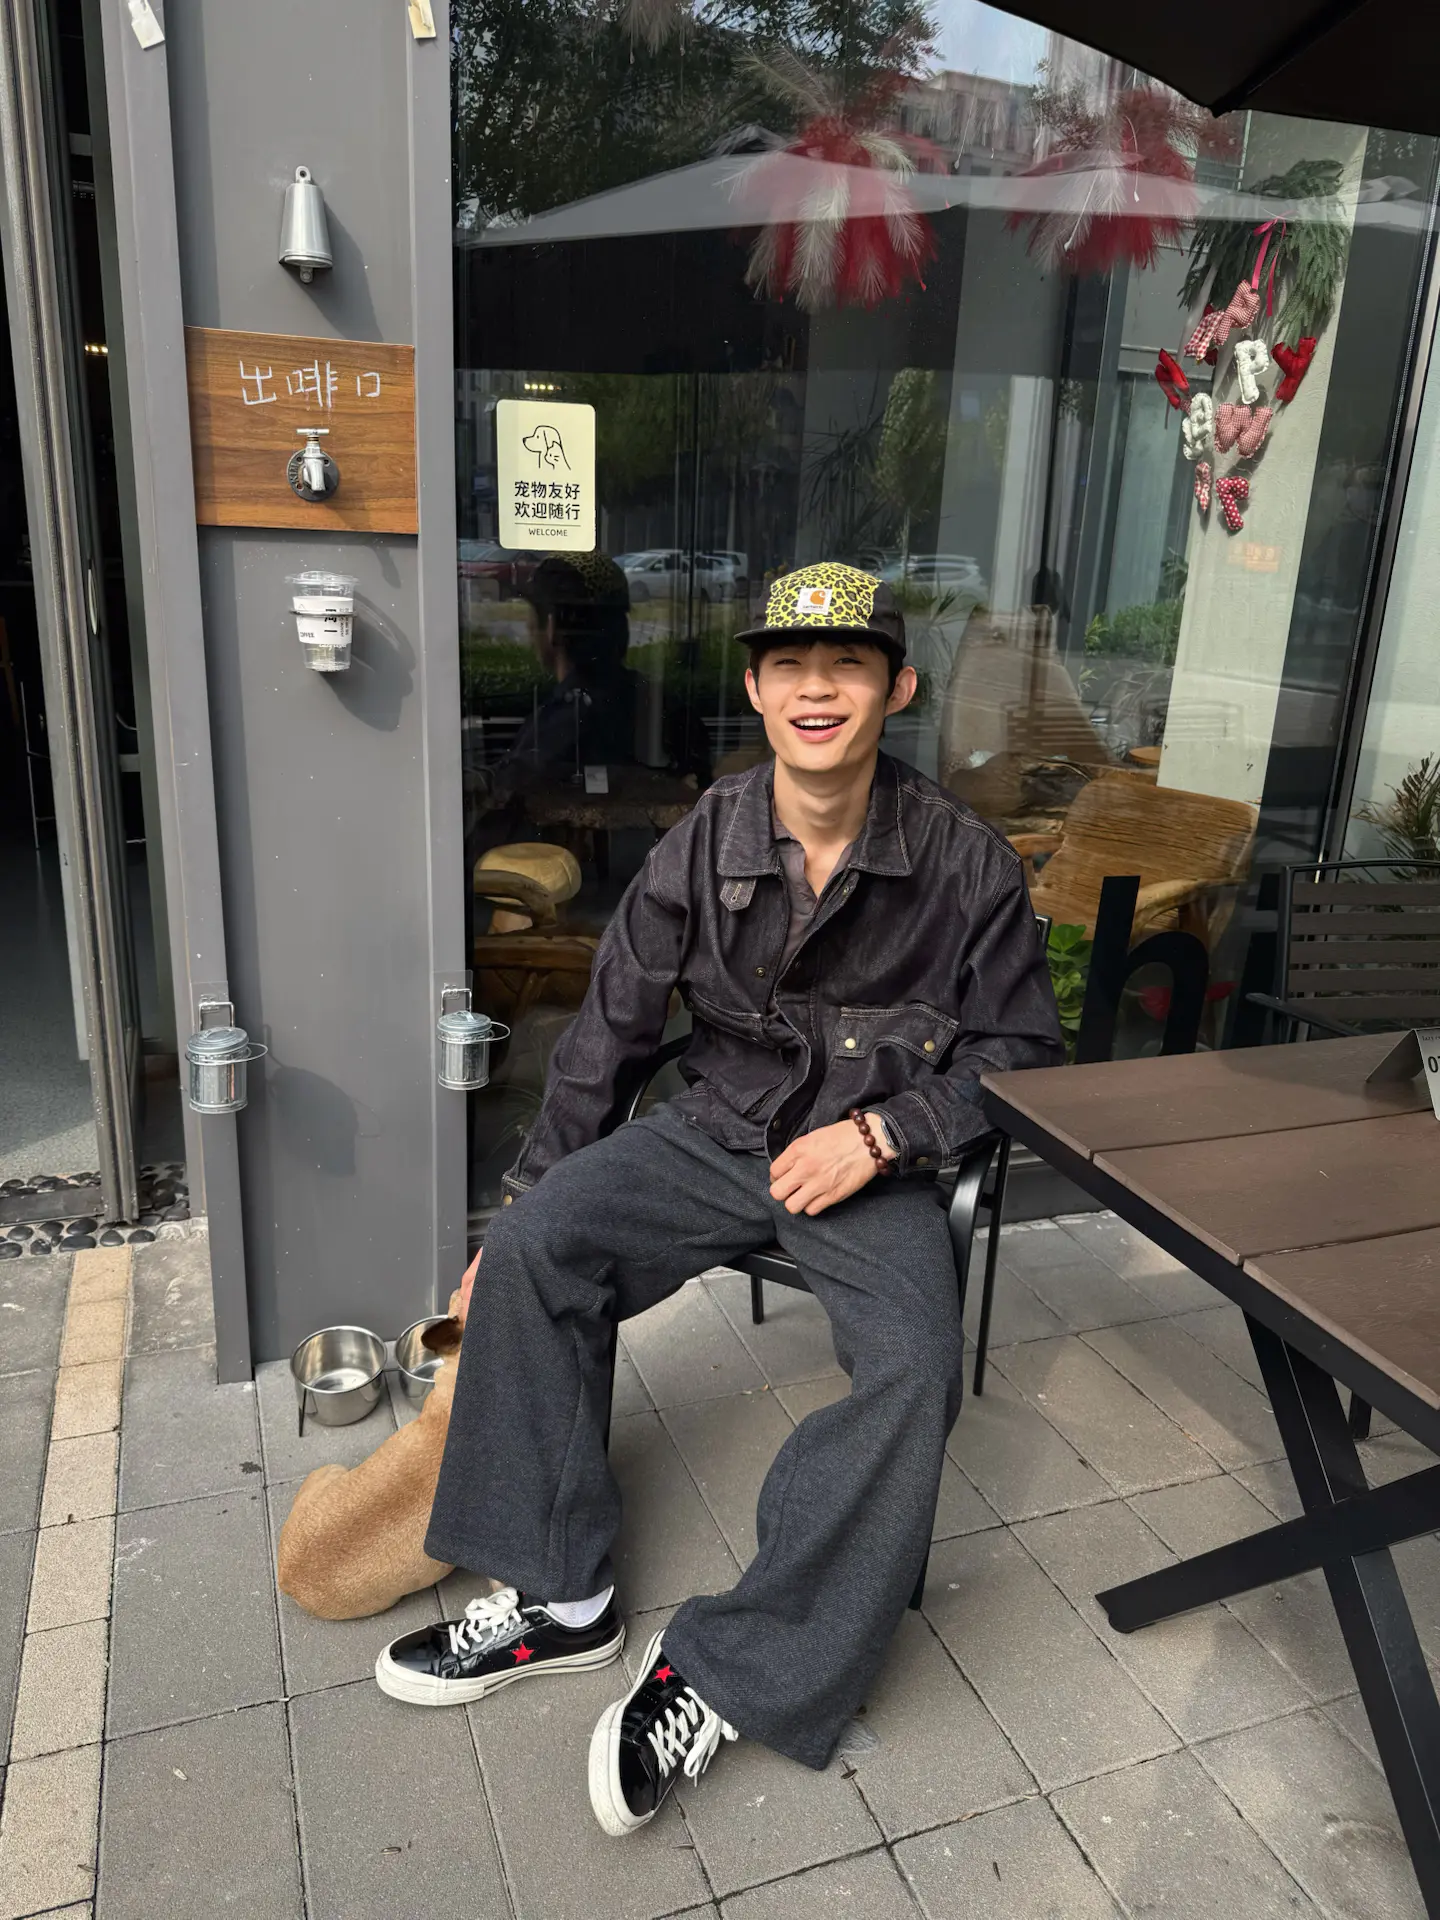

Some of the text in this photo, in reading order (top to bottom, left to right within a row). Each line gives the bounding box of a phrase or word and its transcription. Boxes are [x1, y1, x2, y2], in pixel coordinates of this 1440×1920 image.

[239, 360, 381, 408] 出啡口
[514, 480, 581, 500] 宠物友好
[514, 501, 581, 520] 欢迎随行
[528, 528, 568, 537] WELCOME
[1428, 1055, 1440, 1073] 0
